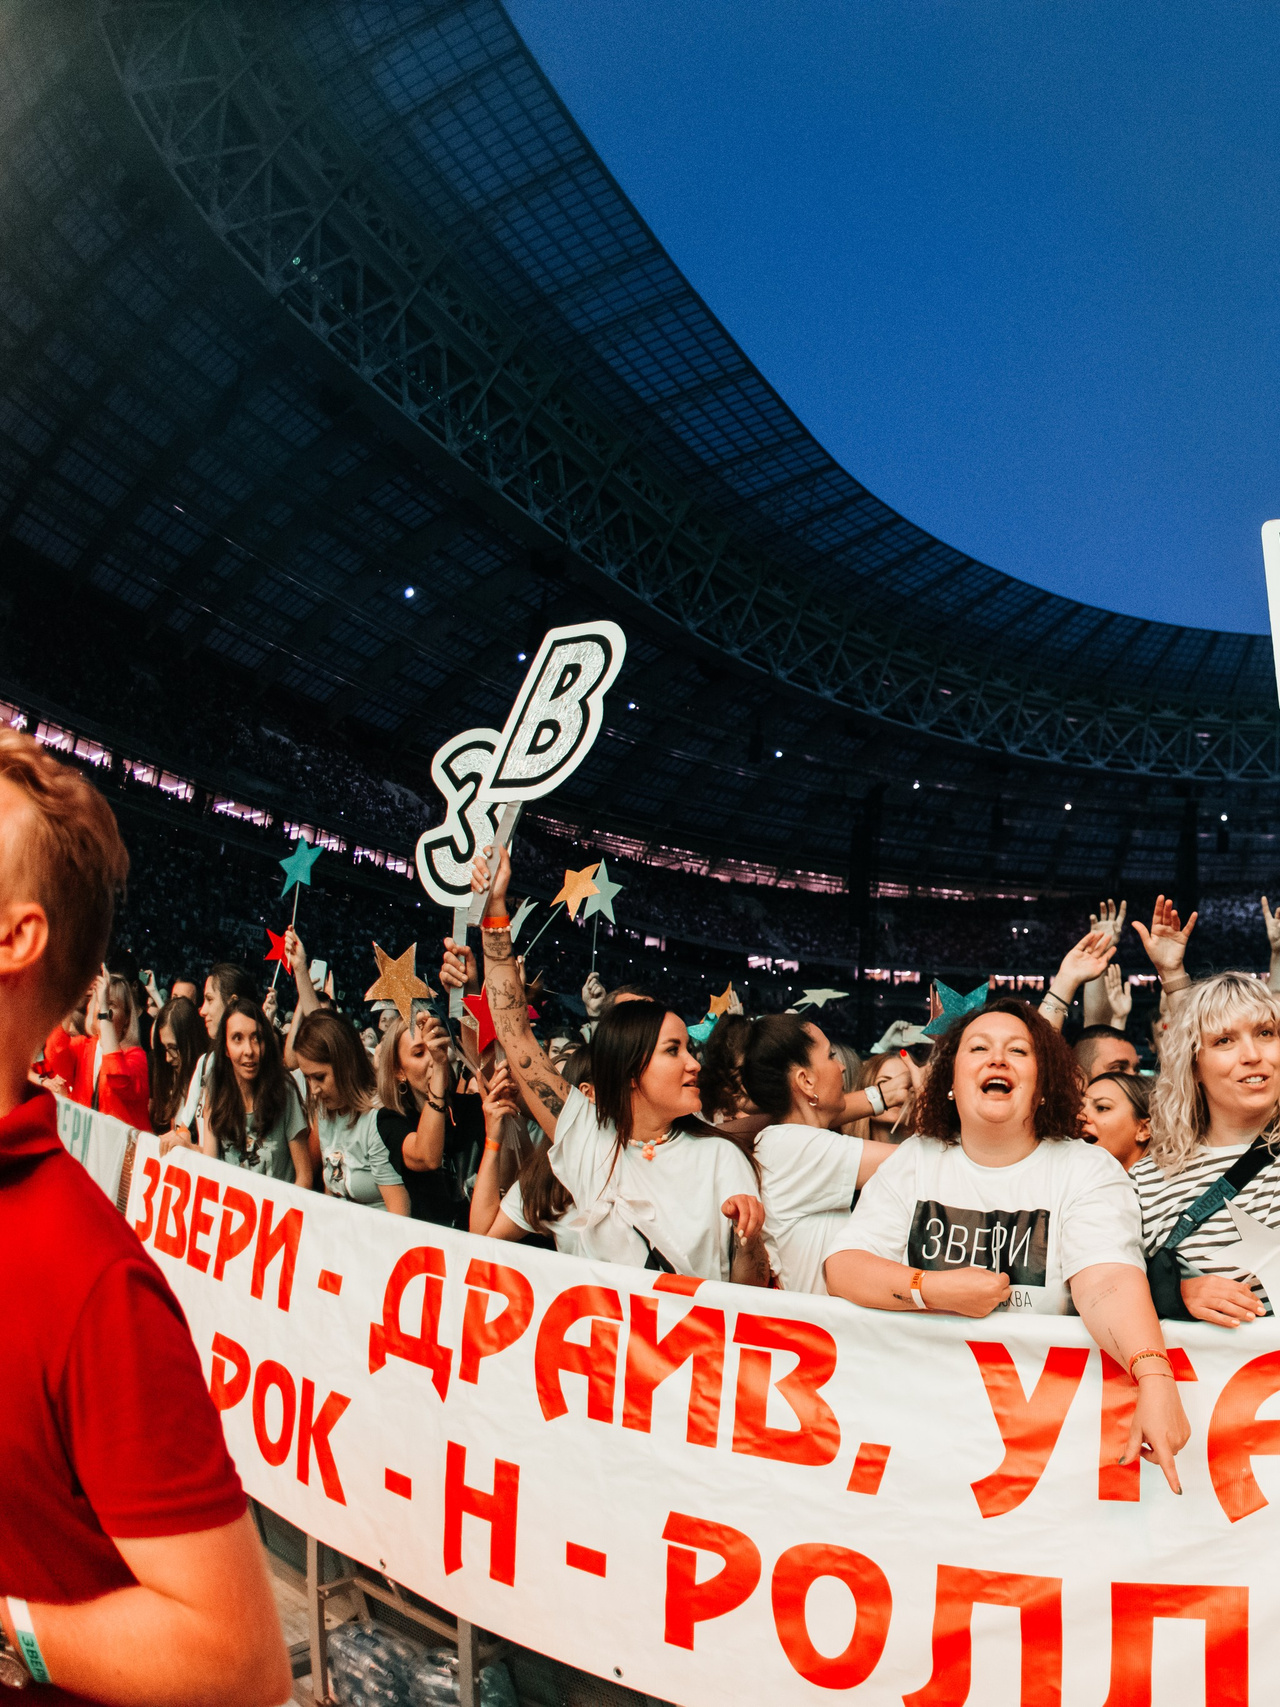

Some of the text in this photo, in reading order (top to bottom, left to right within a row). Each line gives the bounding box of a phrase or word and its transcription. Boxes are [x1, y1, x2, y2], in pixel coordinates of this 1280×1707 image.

[488, 633, 613, 790] В
[921, 1217, 1032, 1269] ЗВЕРИ
[135, 1157, 304, 1313] ЗВЕРИ
[368, 1246, 892, 1496] ДРАЙВ,
[210, 1331, 352, 1507] РОК
